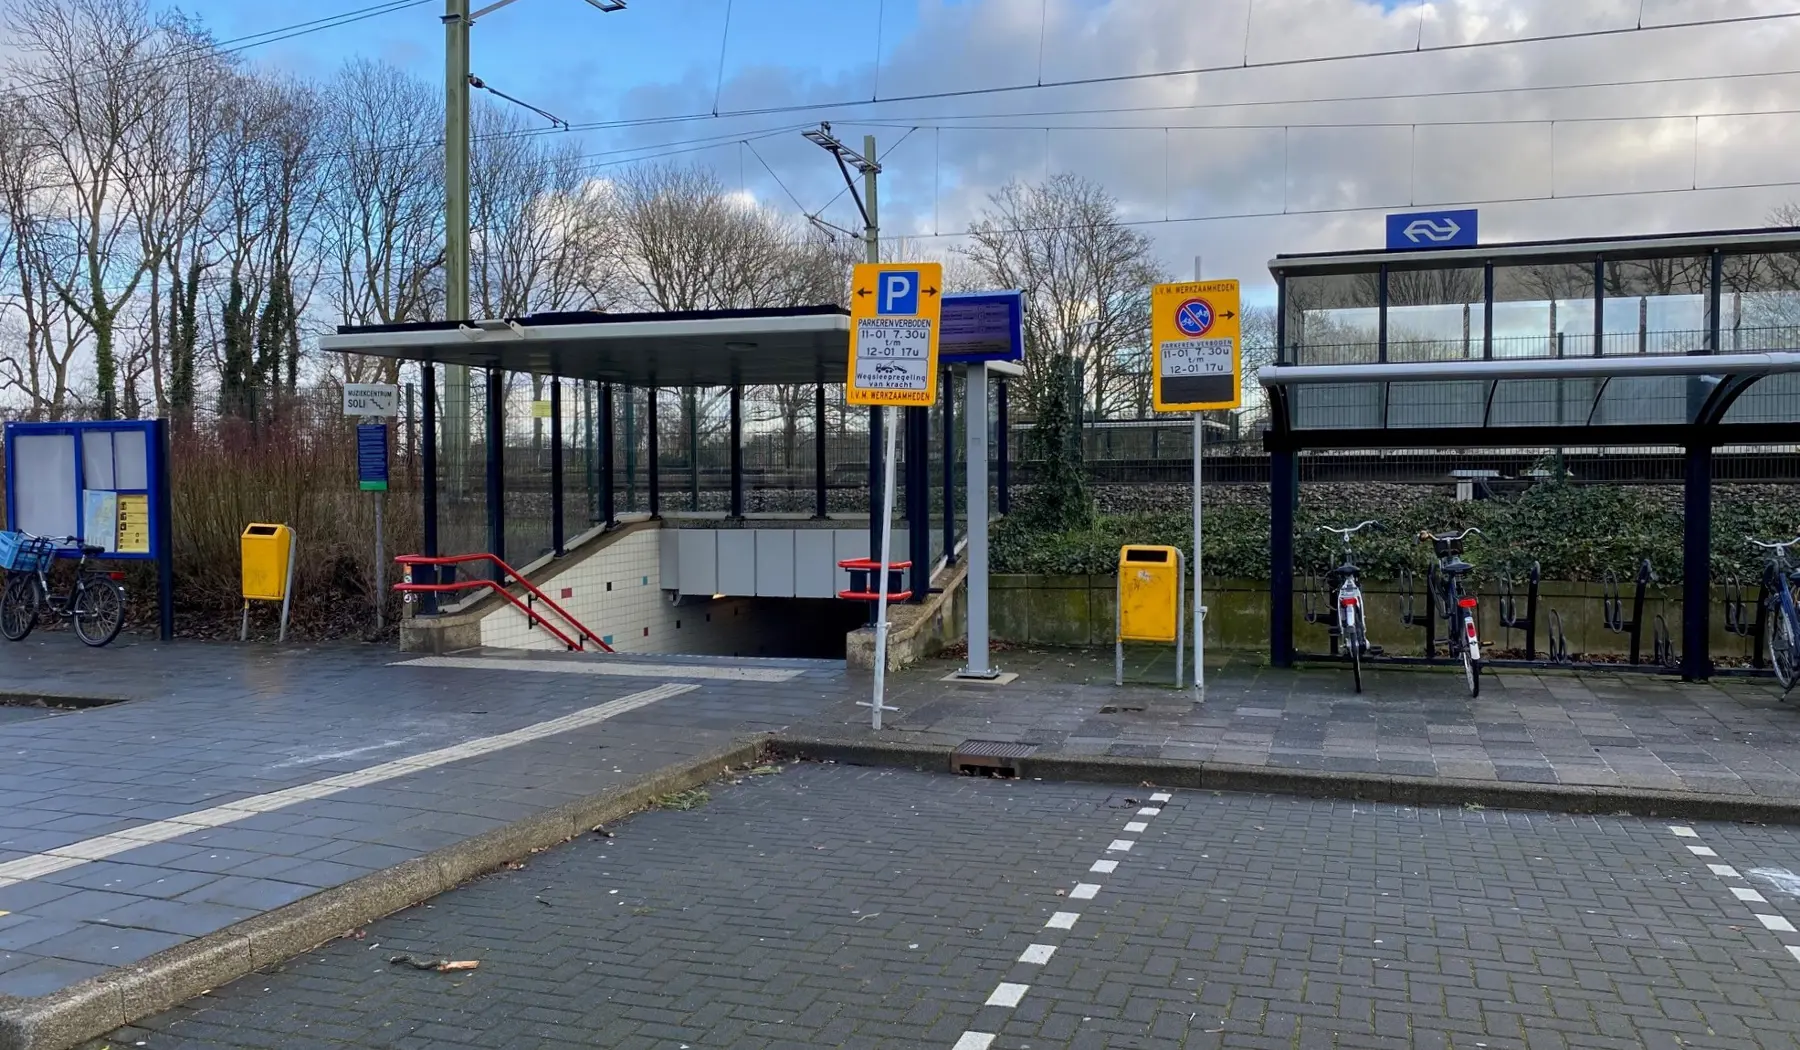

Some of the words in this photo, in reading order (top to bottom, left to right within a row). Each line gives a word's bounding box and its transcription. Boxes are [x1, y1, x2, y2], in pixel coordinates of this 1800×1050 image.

[886, 276, 911, 311] P
[1176, 283, 1235, 294] WERKZAAMHEDEN
[858, 318, 894, 327] PARKEREN
[895, 318, 931, 328] VERBODEN
[862, 330, 886, 339] 11-01
[867, 347, 895, 356] 12-01
[901, 347, 919, 357] 17u
[1163, 349, 1188, 358] 11-01
[1170, 364, 1199, 374] 12-01
[1206, 363, 1223, 372] 17u
[857, 373, 926, 382] Wegsleepregeling
[871, 391, 931, 401] WERKZAAMHEDEN
[347, 398, 366, 408] SOLI
